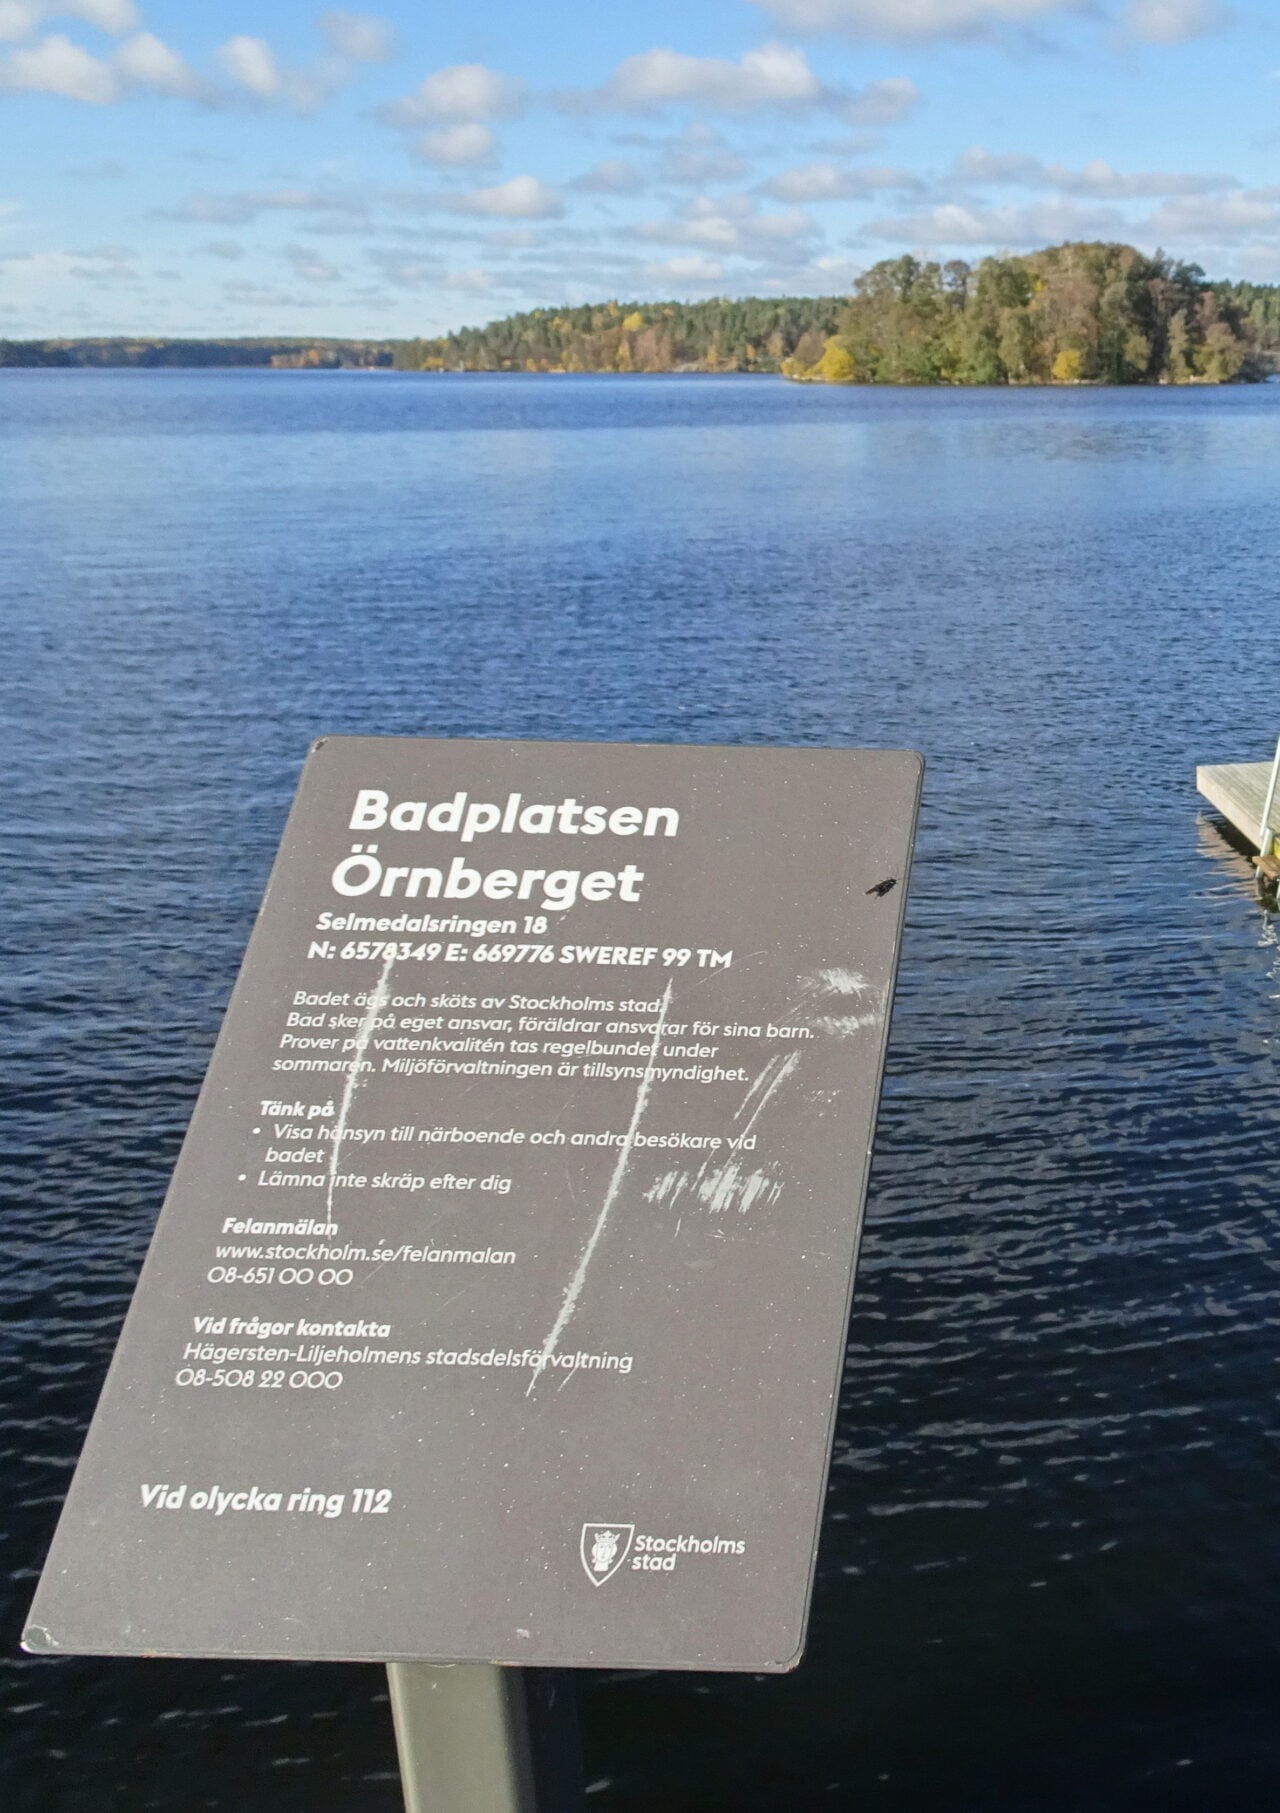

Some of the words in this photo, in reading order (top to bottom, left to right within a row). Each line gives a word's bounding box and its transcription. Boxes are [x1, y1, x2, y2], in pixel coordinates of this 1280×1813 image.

[349, 789, 679, 842] Badplatsen
[331, 844, 645, 911] Örnberget
[316, 912, 517, 938] Selmedalsringen
[523, 916, 548, 934] 18
[308, 941, 335, 960] N:
[340, 942, 440, 962] 6578349
[445, 944, 467, 962] E:
[472, 945, 554, 964] 669776
[559, 946, 657, 967] SWEREF
[661, 948, 691, 967] 99
[696, 950, 732, 969] TM
[293, 991, 350, 1007] Badet
[391, 993, 426, 1009] och
[430, 994, 476, 1009] sköts
[481, 998, 503, 1010] av
[508, 995, 614, 1012] Stockholms
[286, 1012, 325, 1028] Bad
[328, 1013, 366, 1028] sker
[370, 1014, 396, 1031] på
[400, 1016, 443, 1033] eget
[447, 1019, 513, 1034] ansvar,
[518, 1016, 602, 1034] föräldrar
[606, 1021, 688, 1036] ansvarar
[692, 1021, 720, 1037] för
[724, 1022, 761, 1038] sina
[766, 1023, 814, 1040] barn.
[280, 1034, 339, 1050] Prover
[373, 1036, 505, 1053] vattenkvalitén
[510, 1040, 538, 1054] tas
[543, 1040, 658, 1059] regelbundet
[662, 1043, 719, 1058] under
[272, 1057, 376, 1073] sommaren.
[381, 1058, 552, 1079] Miljöförvaltningen
[558, 1062, 579, 1077] är
[582, 1062, 749, 1083] tillsynsmyndighet.
[260, 1100, 304, 1117] Tänk
[307, 1101, 335, 1120] på
[274, 1124, 313, 1140] Visa
[390, 1126, 415, 1141] till
[418, 1126, 525, 1145] närboende
[529, 1130, 566, 1145] och
[570, 1130, 630, 1147] andra
[634, 1131, 722, 1149] besökare
[727, 1134, 757, 1150] vid
[265, 1147, 325, 1163] badet
[258, 1170, 325, 1187] Lämna
[331, 1172, 367, 1188] inte
[371, 1173, 425, 1192] skräp
[430, 1174, 476, 1190] efter
[480, 1176, 512, 1195] dig
[222, 1217, 338, 1236] Felanmälan
[215, 1244, 516, 1265] www.stockholm.se/felanmalan
[207, 1266, 275, 1284] 08-651
[278, 1268, 314, 1285] 00
[318, 1268, 354, 1286] 00
[193, 1317, 226, 1335] Vid
[228, 1317, 295, 1339] frågor
[296, 1319, 391, 1338] kontakta
[183, 1342, 421, 1366] Hägersten-Liljeholmens
[425, 1348, 633, 1373] stadsdelsförvaltning
[175, 1368, 254, 1387] 08-508
[257, 1371, 285, 1388] 22
[289, 1370, 343, 1389] 000
[140, 1484, 187, 1510] Vid
[190, 1485, 283, 1516] olycka
[286, 1487, 345, 1519] ring
[351, 1488, 393, 1514] 112
[634, 1534, 746, 1555] Stockholms
[631, 1553, 677, 1571] stad
